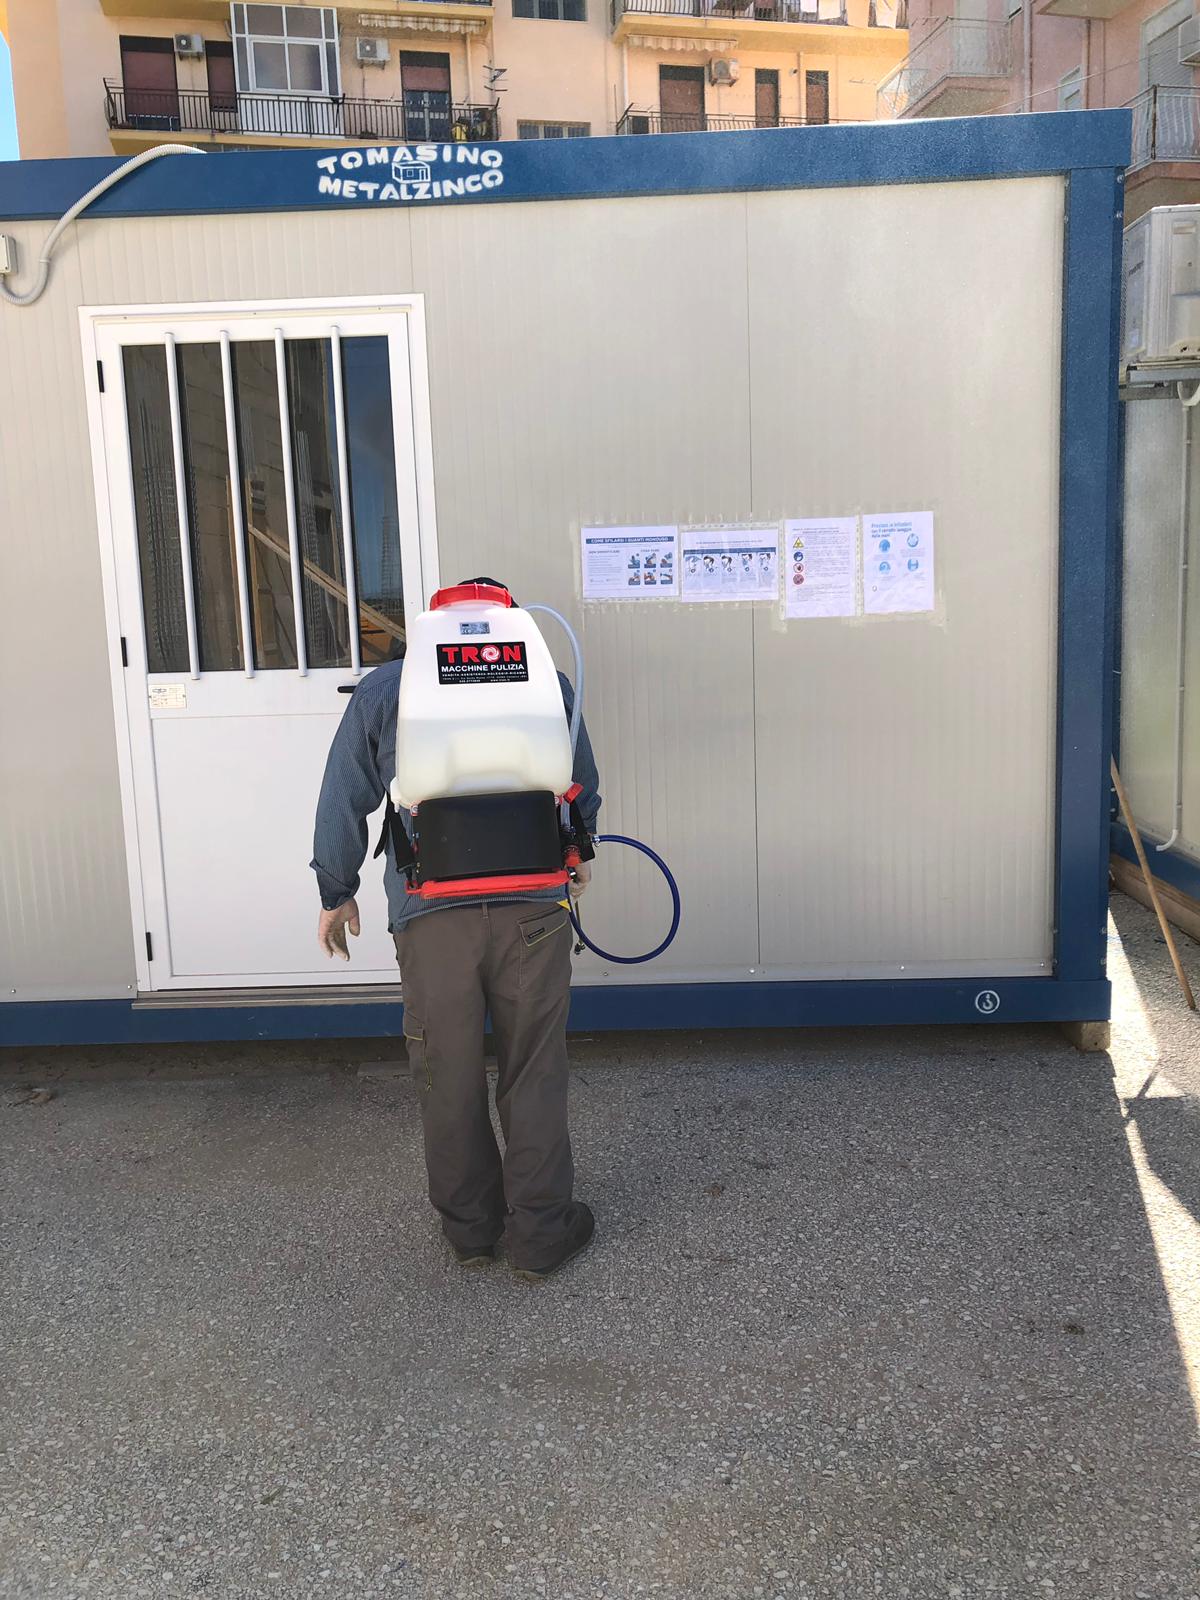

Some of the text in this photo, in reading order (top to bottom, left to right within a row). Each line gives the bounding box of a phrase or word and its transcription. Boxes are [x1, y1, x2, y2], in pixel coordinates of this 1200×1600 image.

[317, 144, 503, 175] TOMASINO
[318, 169, 504, 200] METALZINCO
[442, 645, 521, 663] TRON
